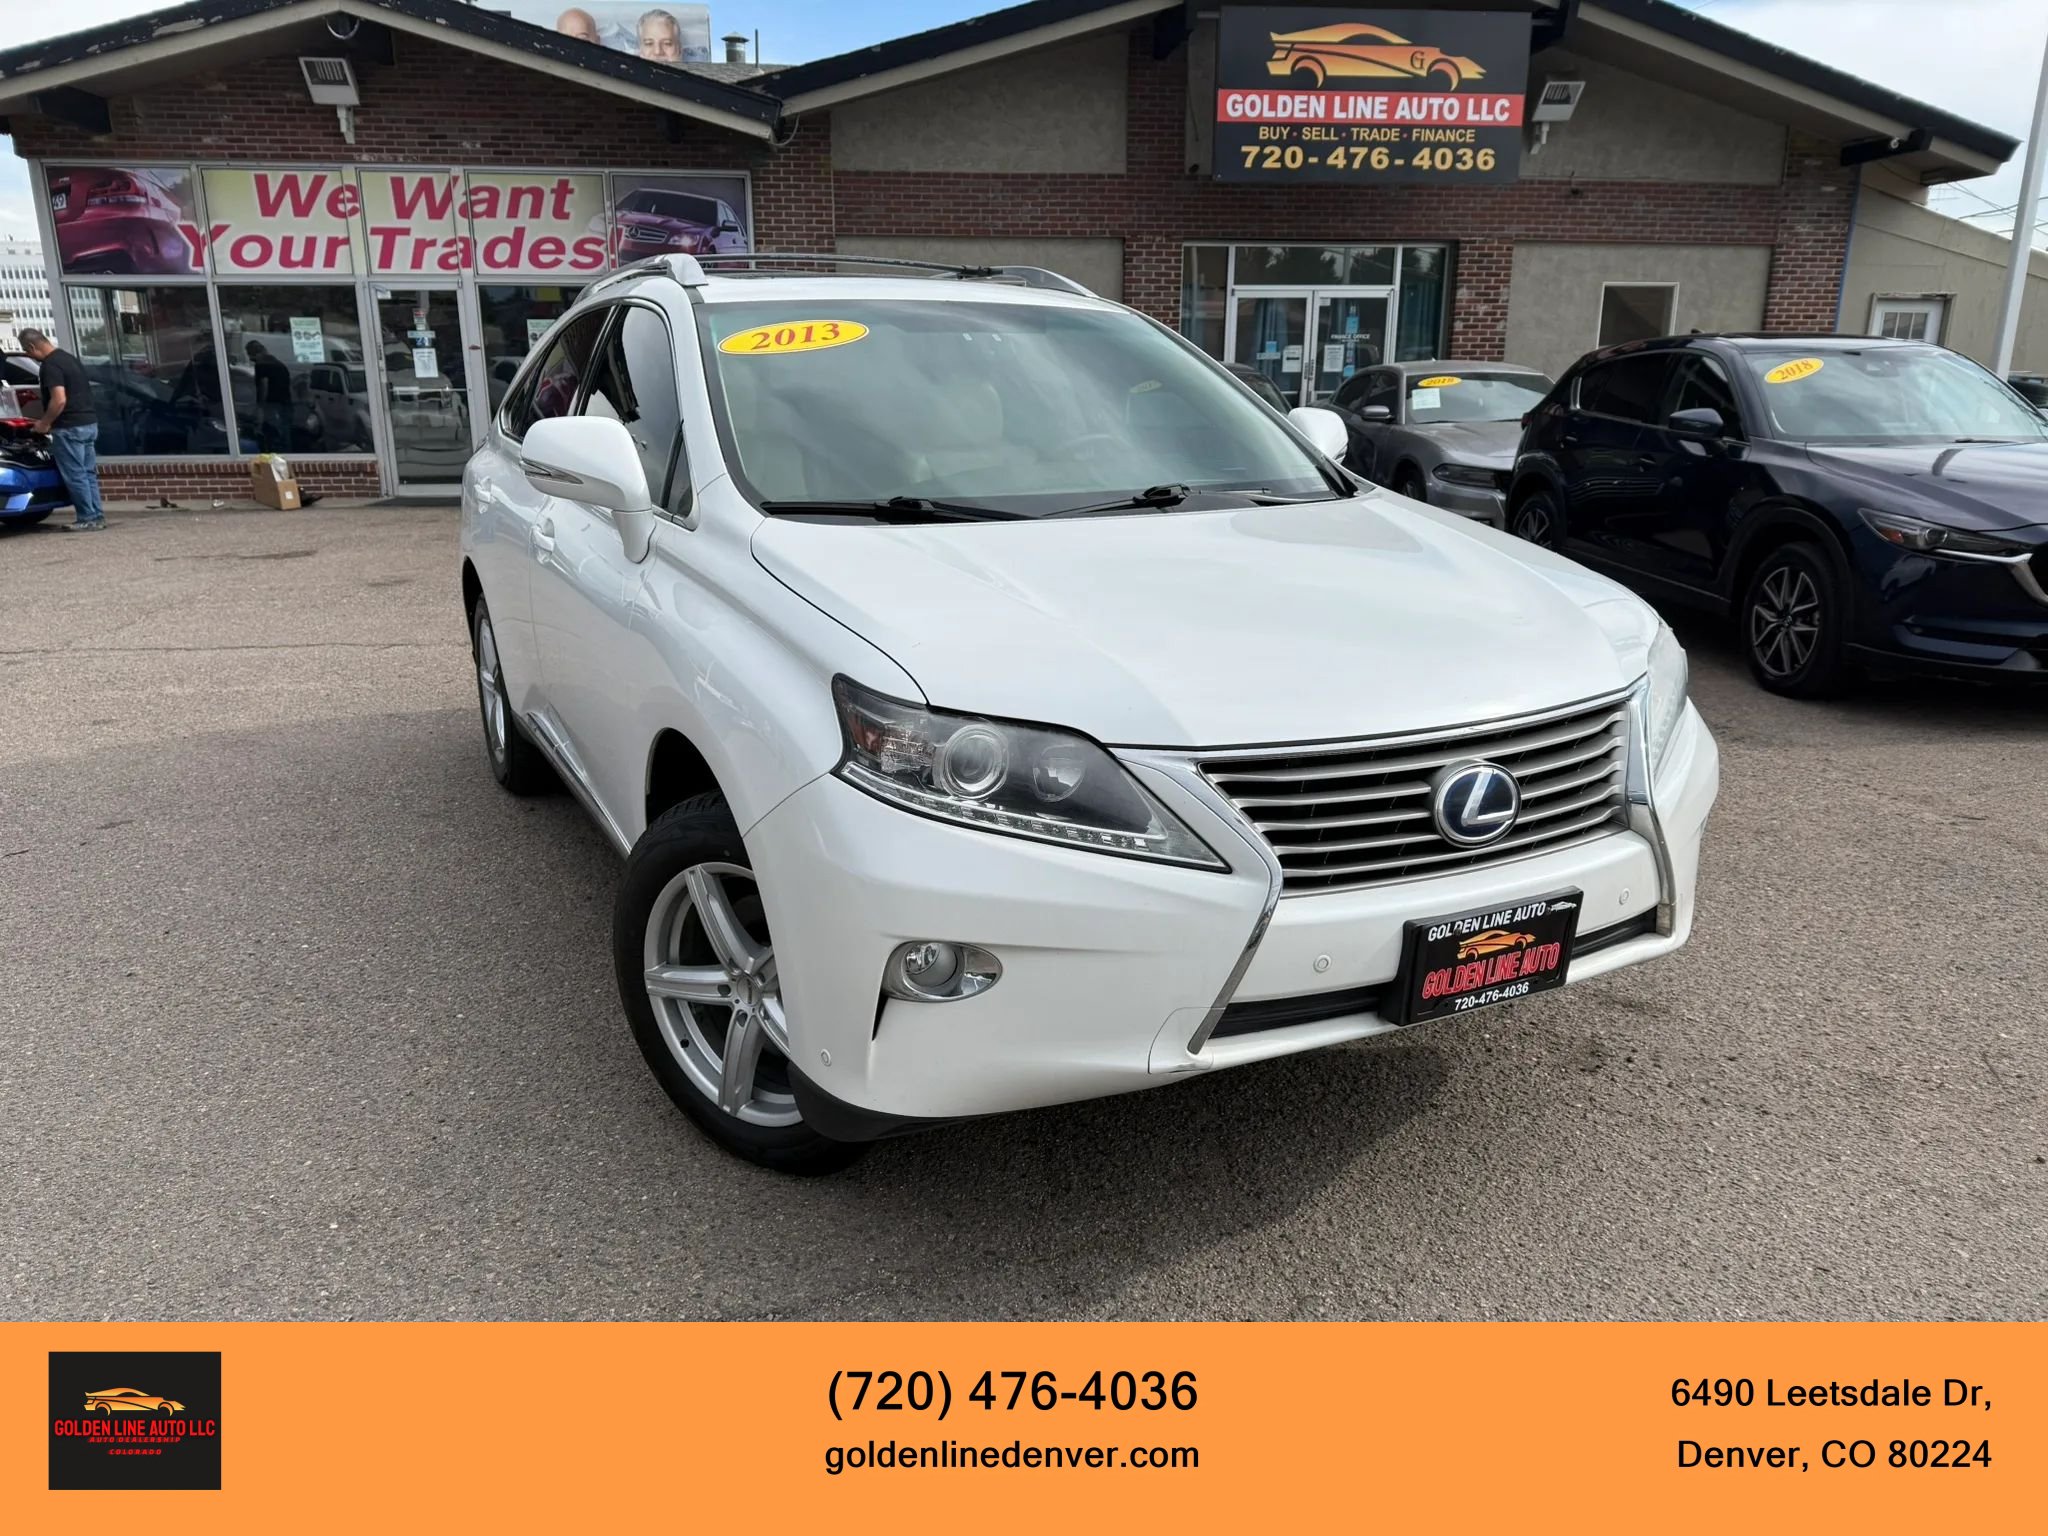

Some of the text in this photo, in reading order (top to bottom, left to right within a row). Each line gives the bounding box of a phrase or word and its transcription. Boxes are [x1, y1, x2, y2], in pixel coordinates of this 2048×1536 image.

[1226, 93, 1511, 122] GOLDEN LINE AUTO LLC
[1259, 126, 1476, 143] BUY SELL TRADE FINANCE
[253, 173, 576, 220] We Want
[177, 224, 623, 271] Your Trades!
[751, 323, 840, 350] 2013
[1775, 360, 1814, 380] 2018
[1427, 902, 1546, 942] GOLDEN LINE AUTO
[1422, 942, 1560, 999] GOLDEN LINE AUTO
[1454, 982, 1530, 1011] 720-476-4036
